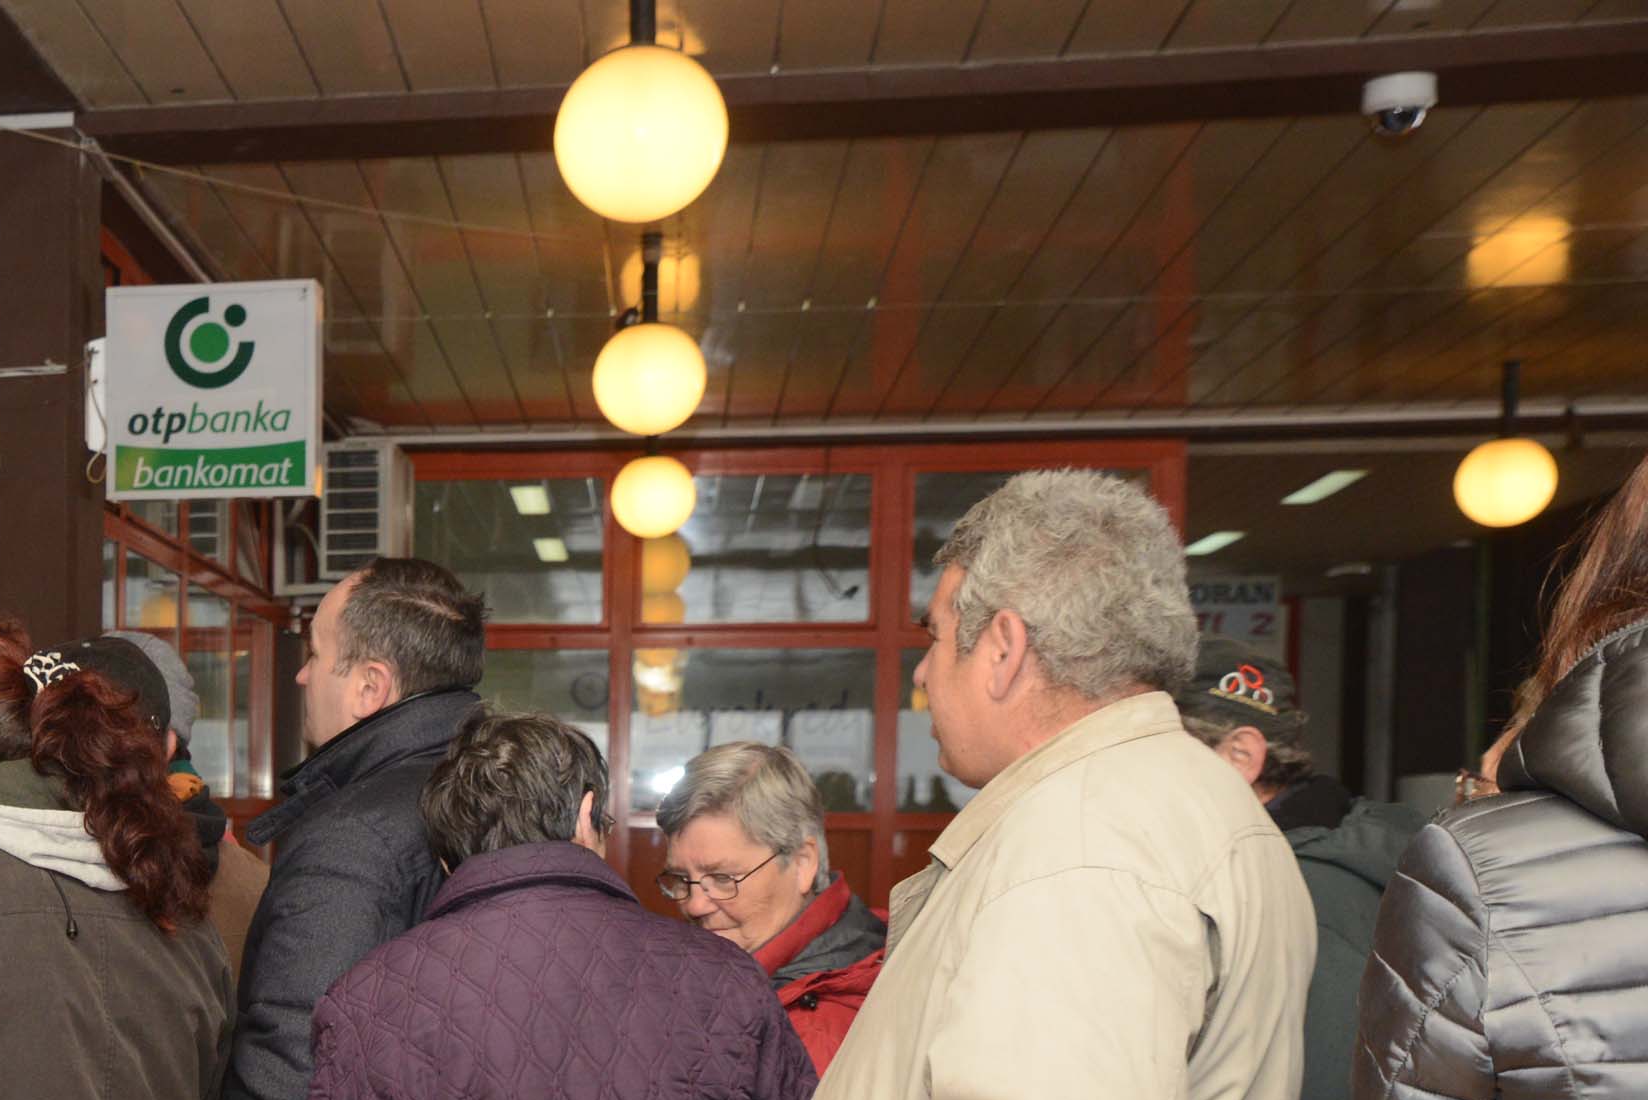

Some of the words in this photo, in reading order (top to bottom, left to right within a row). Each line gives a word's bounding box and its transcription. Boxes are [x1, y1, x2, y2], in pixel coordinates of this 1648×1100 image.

[127, 400, 291, 444] otpbanka
[132, 455, 294, 488] bankomat
[1189, 583, 1276, 605] ORAN
[1249, 612, 1275, 635] 2
